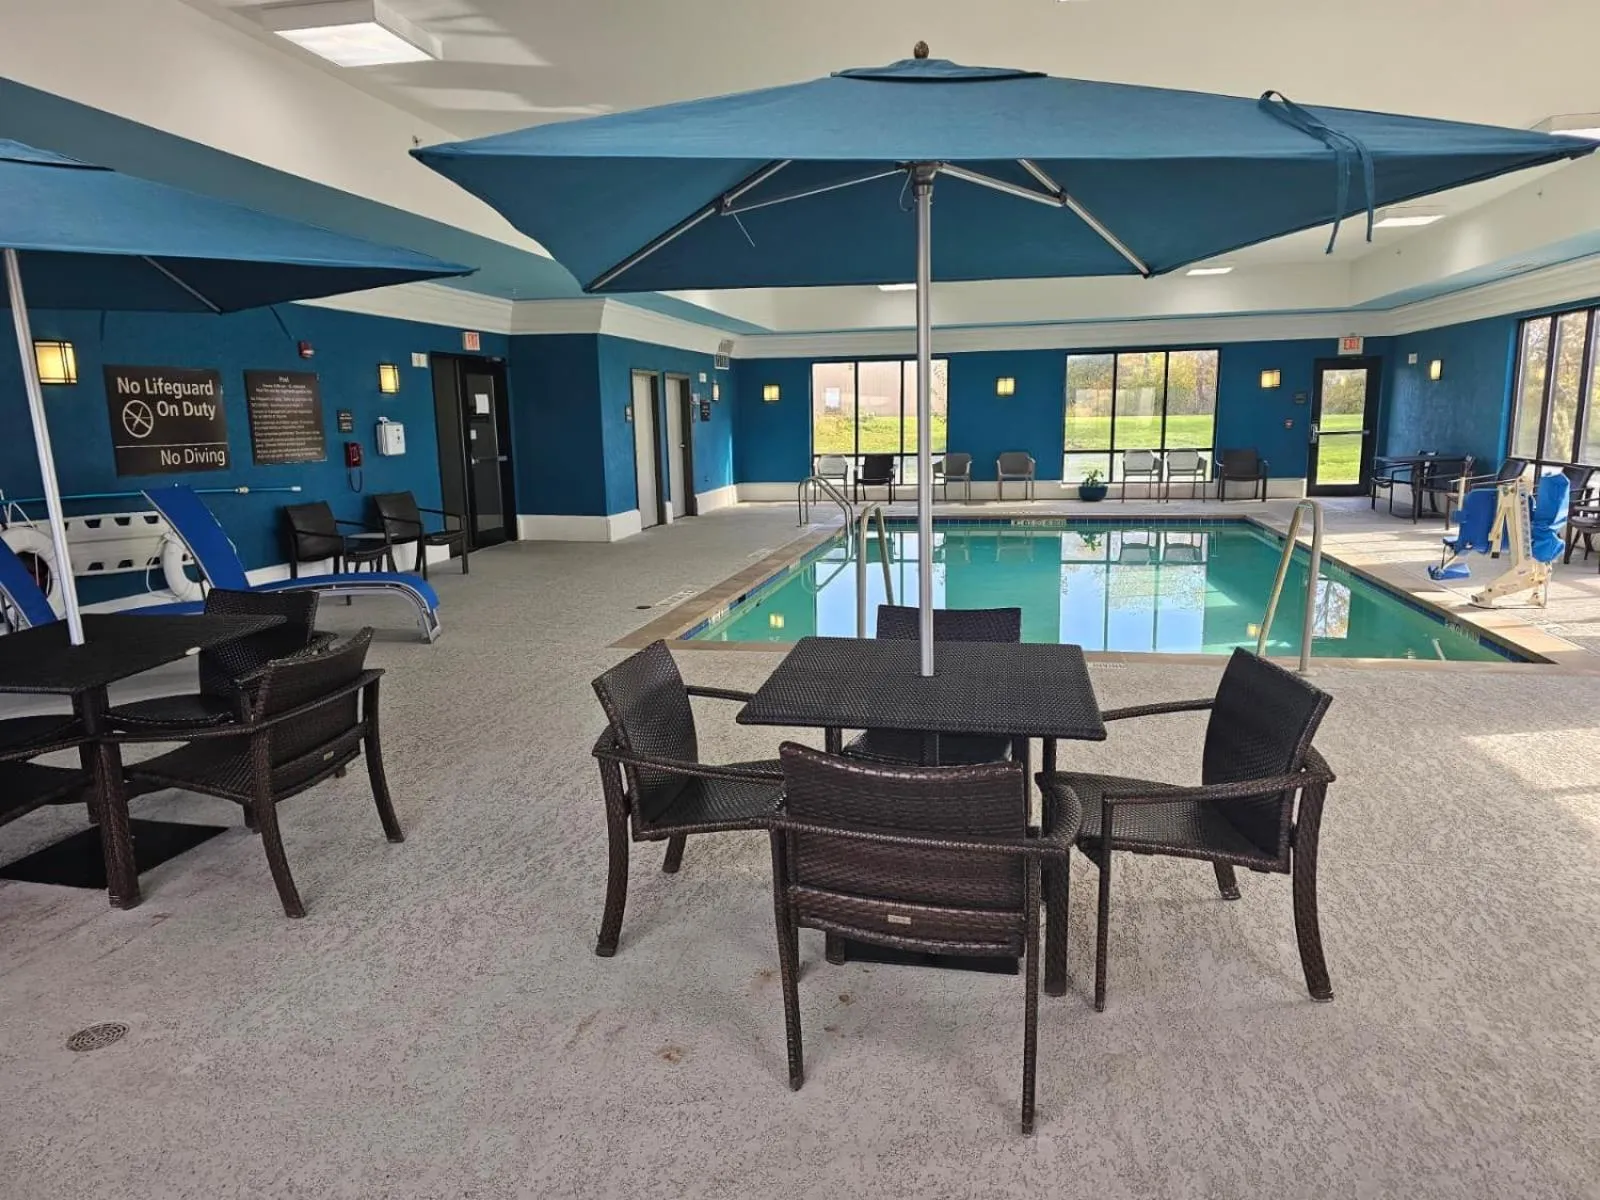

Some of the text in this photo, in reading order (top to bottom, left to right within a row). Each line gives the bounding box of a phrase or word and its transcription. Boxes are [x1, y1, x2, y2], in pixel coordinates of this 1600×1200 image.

[117, 377, 214, 399] No Lifeguard
[157, 400, 216, 421] On Duty
[160, 448, 226, 467] No Diving
